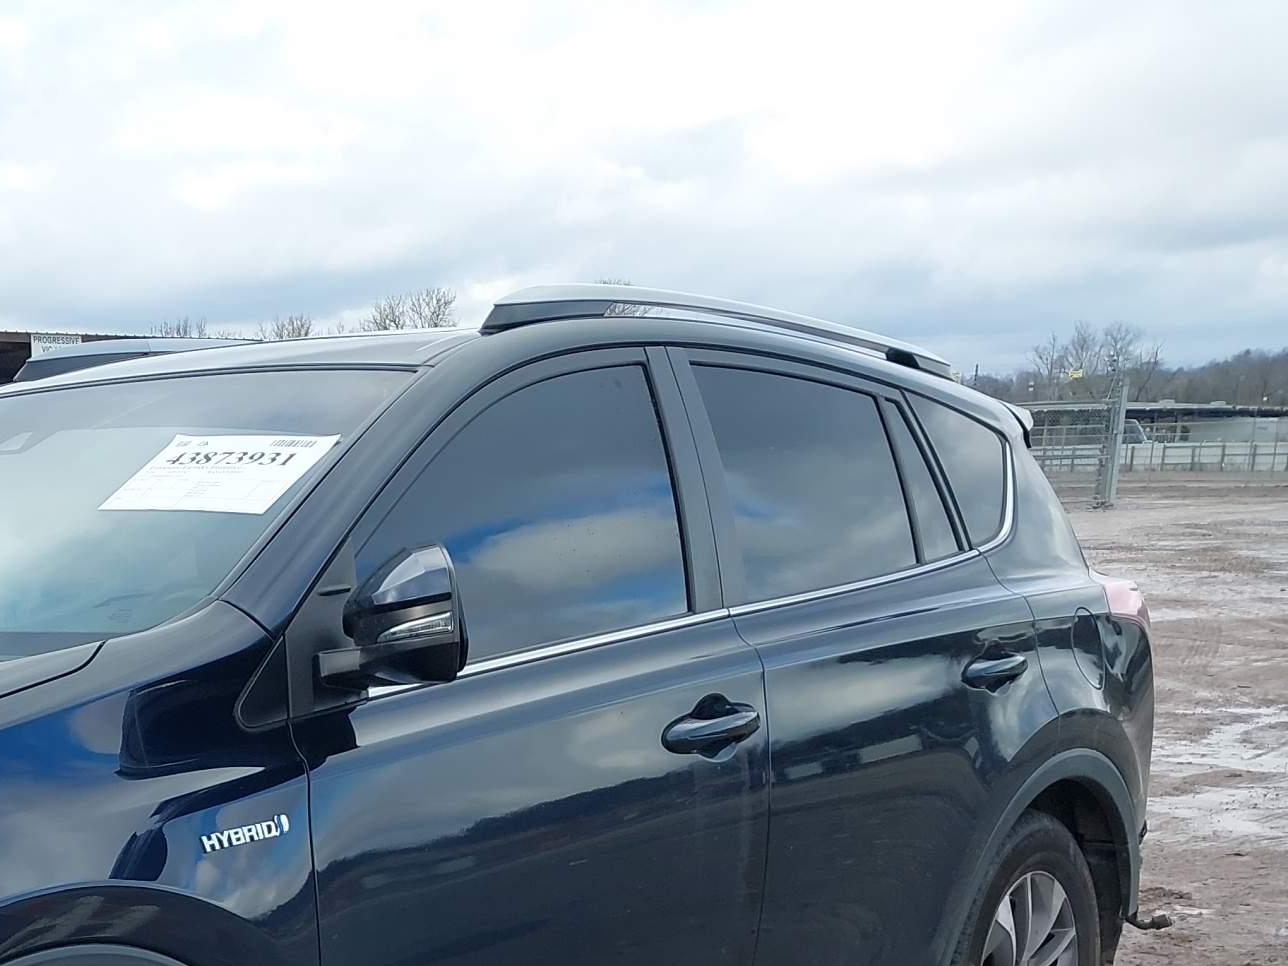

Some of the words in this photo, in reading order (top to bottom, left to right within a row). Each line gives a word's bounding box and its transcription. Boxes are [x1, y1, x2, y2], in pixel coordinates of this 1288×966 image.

[33, 335, 80, 345] PROGRESSIVE
[166, 451, 296, 466] 43873931
[200, 819, 280, 853] HYBRID
